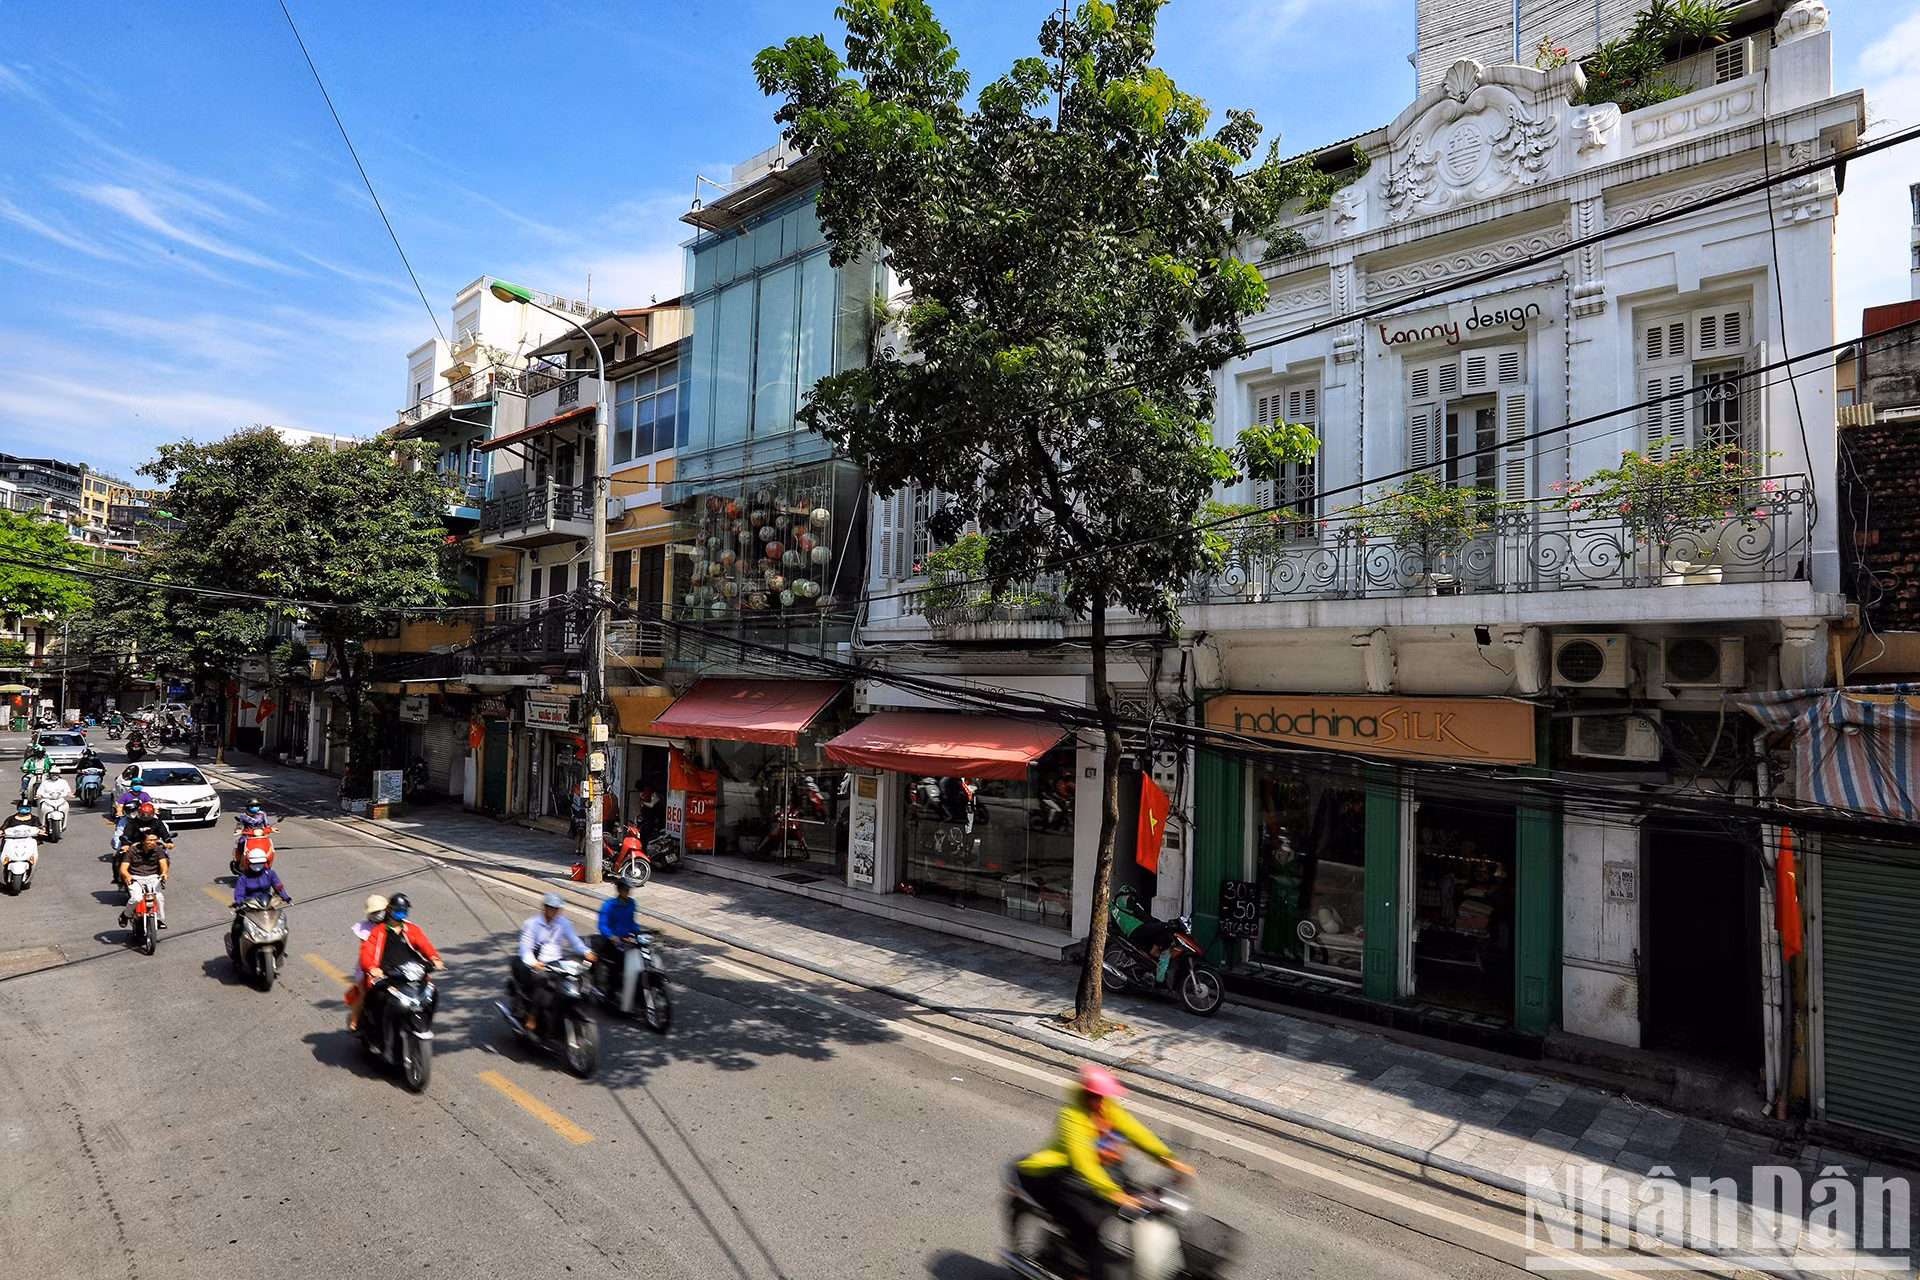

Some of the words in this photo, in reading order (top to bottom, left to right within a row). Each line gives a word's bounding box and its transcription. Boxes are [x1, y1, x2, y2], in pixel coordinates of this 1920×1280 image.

[1379, 320, 1460, 345] tanmy
[1465, 303, 1541, 331] design
[109, 487, 136, 499] MAY
[1234, 706, 1376, 737] indochina
[666, 803, 683, 823] BÉO
